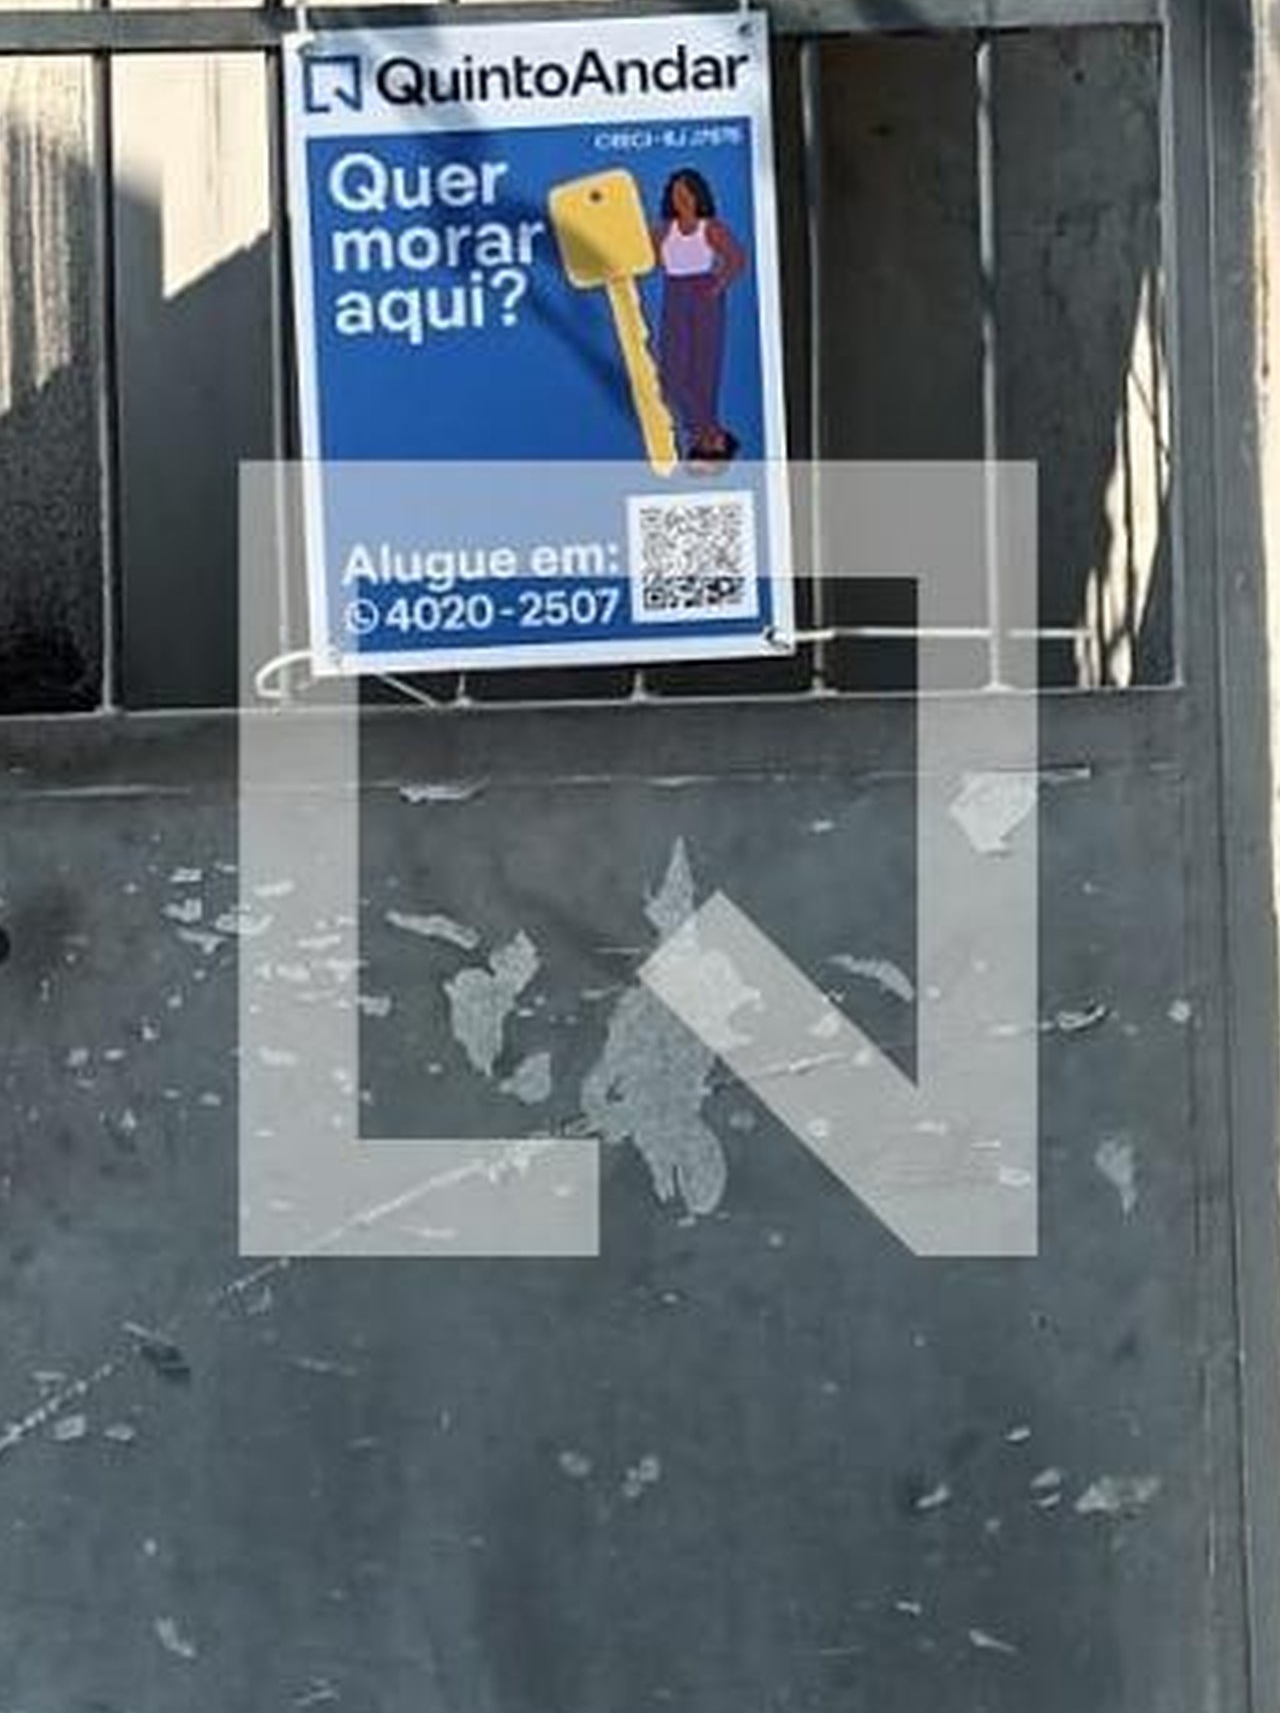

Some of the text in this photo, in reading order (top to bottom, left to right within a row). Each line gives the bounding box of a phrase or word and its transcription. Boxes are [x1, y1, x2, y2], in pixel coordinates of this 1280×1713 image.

[374, 43, 750, 108] QuintoAndar
[328, 152, 509, 212] Quer
[331, 219, 546, 272] morar
[334, 268, 528, 344] aqui?
[341, 542, 620, 593] Alugue em:
